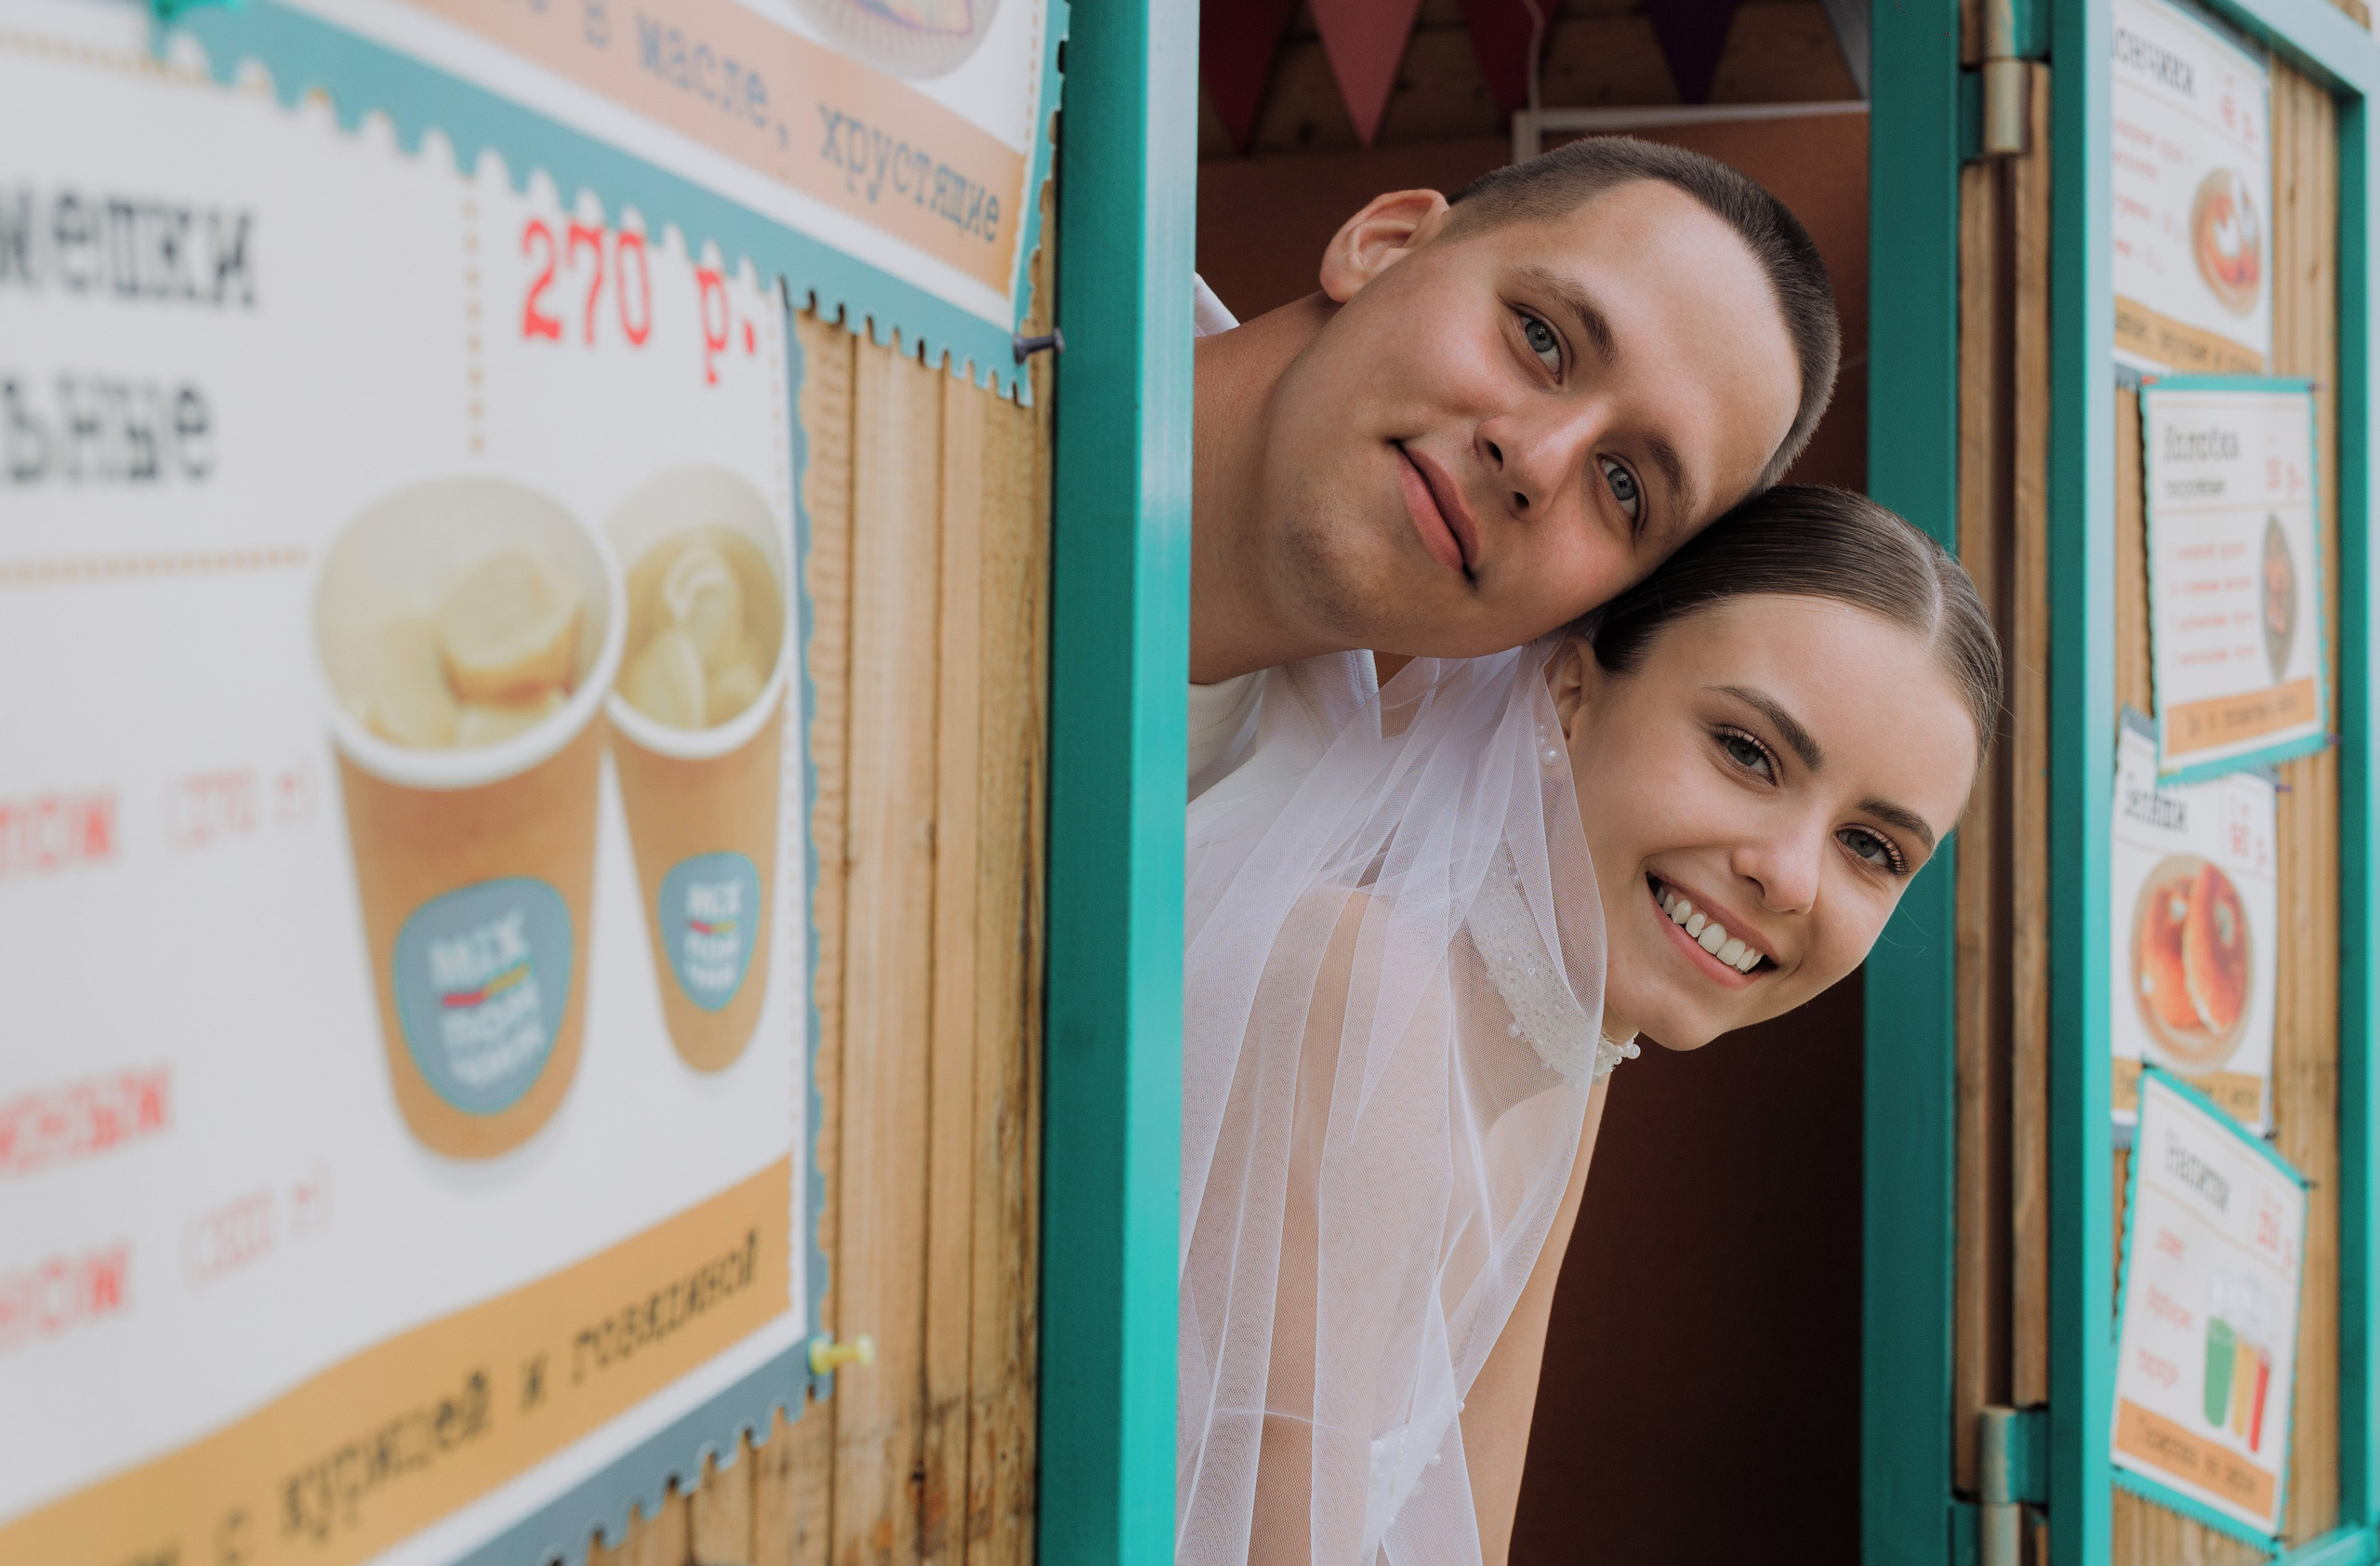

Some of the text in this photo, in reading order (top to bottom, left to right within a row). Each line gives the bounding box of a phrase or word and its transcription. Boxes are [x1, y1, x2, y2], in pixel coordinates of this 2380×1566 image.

[635, 11, 789, 153] масле,
[818, 101, 1001, 244] хрустящие
[2111, 28, 2196, 98] ончики
[519, 219, 756, 385] 270 р.
[571, 1228, 760, 1386] говядиной
